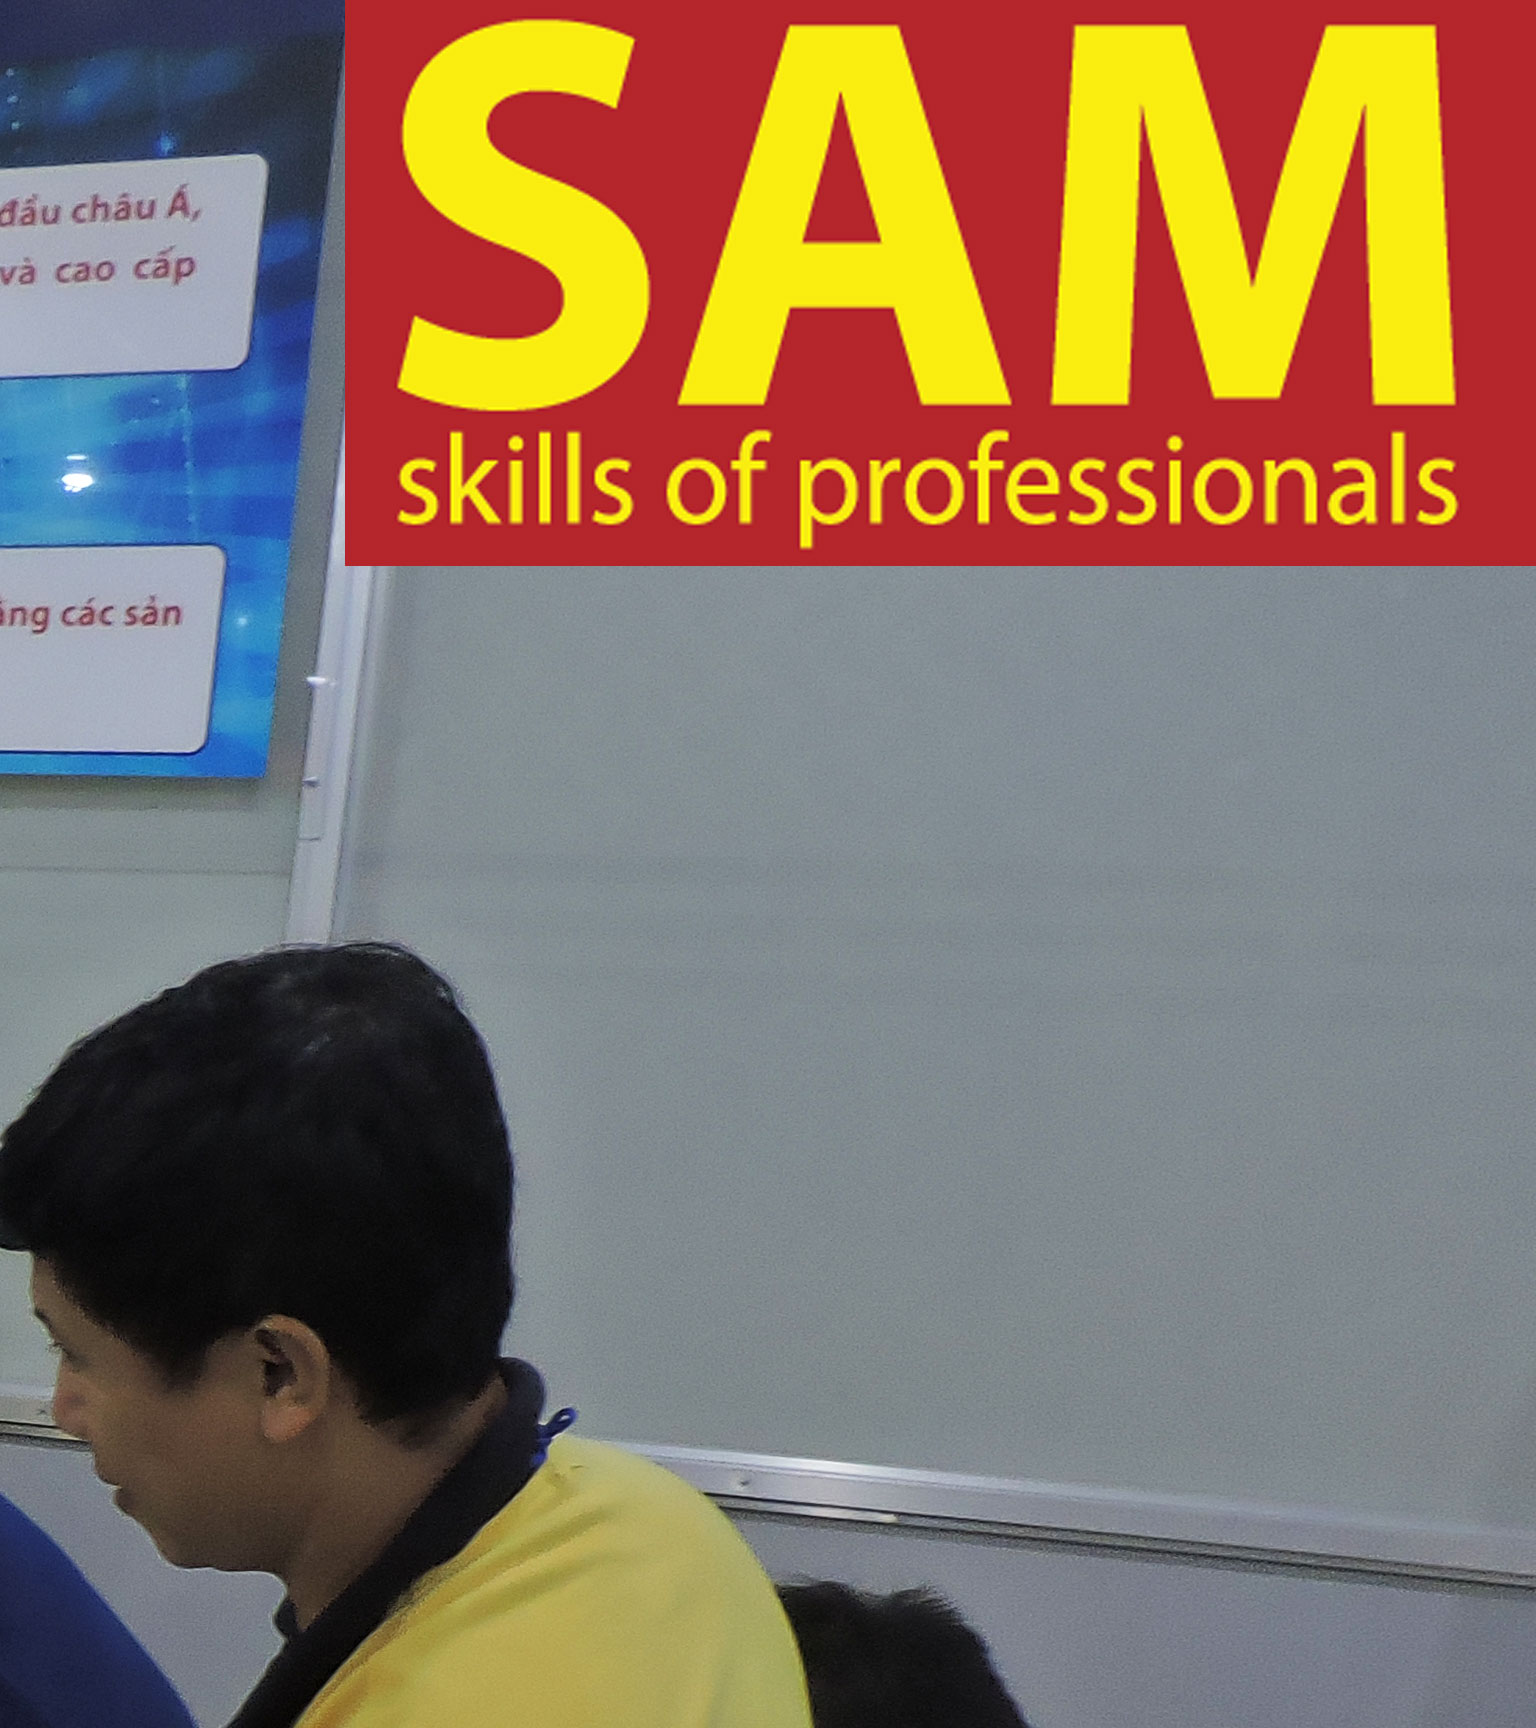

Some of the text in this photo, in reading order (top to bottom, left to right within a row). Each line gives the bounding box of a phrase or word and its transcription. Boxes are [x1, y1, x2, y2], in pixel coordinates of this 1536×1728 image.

[69, 192, 158, 225] châu
[164, 182, 202, 223] Á,
[53, 259, 117, 285] cao
[132, 244, 197, 287] cấp
[58, 596, 116, 628] các
[122, 594, 184, 627] sản
